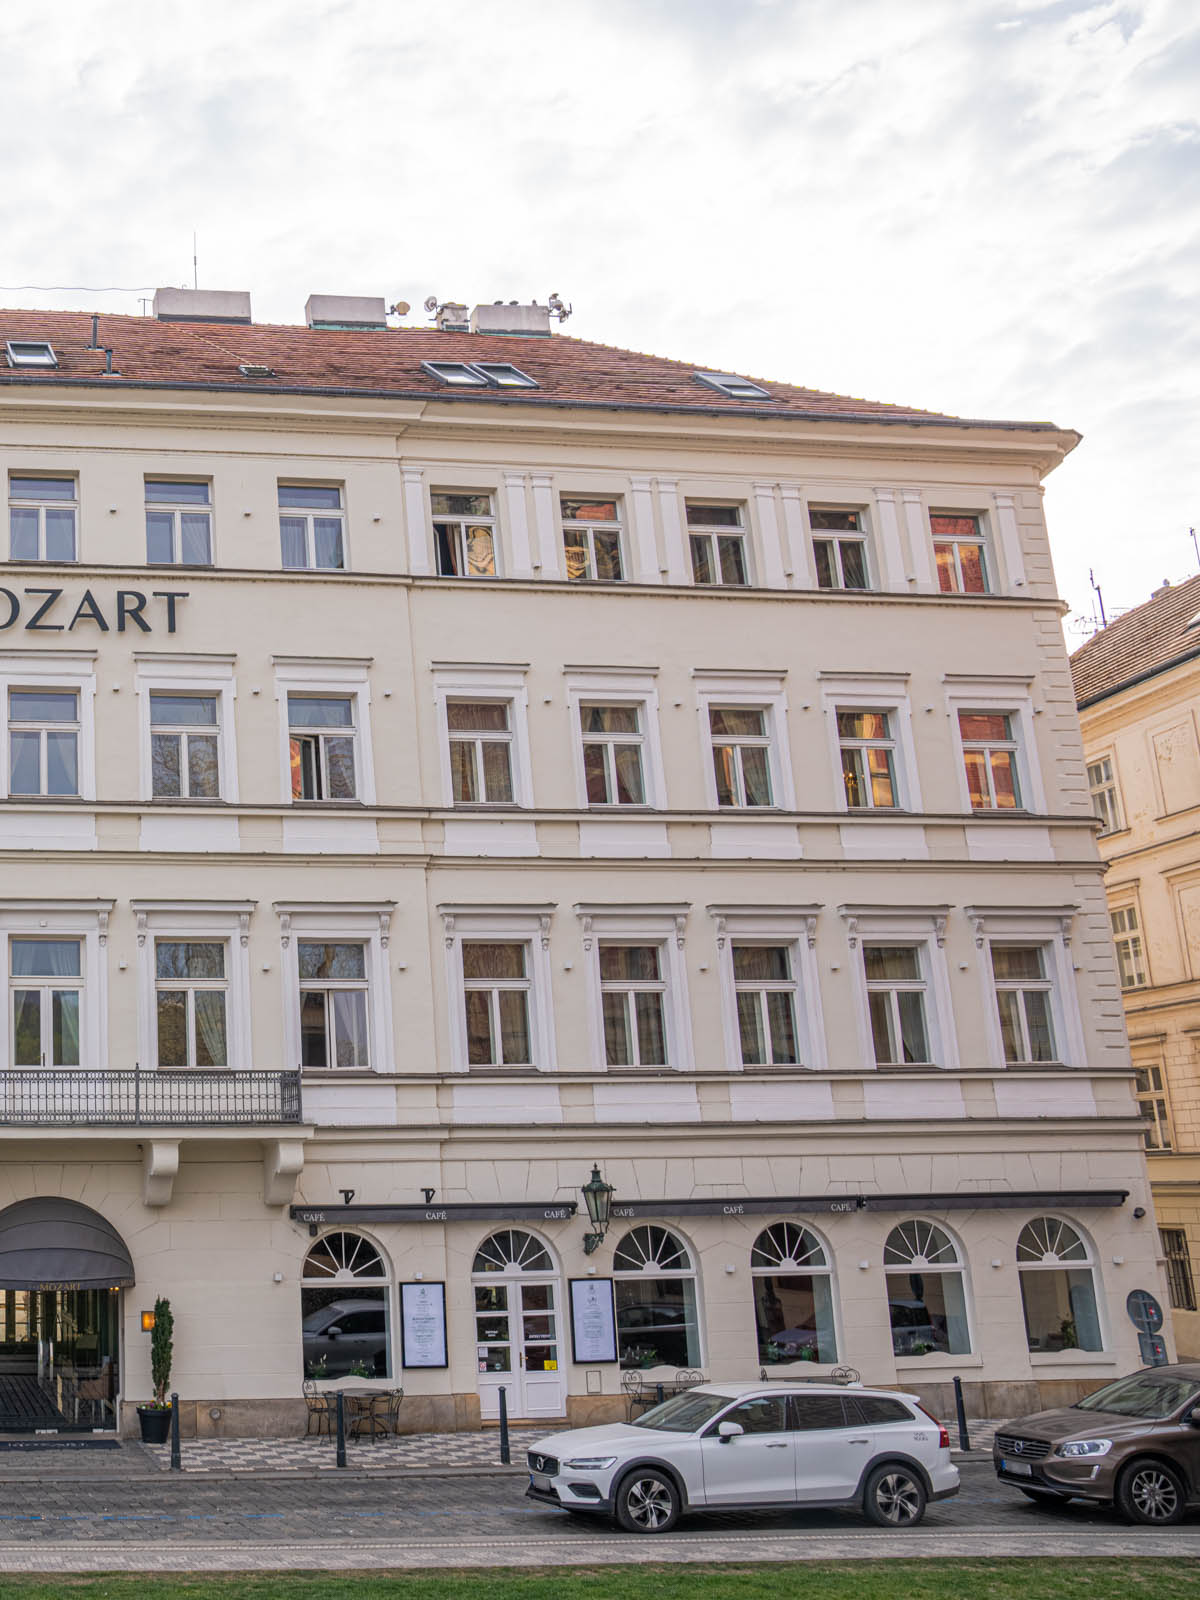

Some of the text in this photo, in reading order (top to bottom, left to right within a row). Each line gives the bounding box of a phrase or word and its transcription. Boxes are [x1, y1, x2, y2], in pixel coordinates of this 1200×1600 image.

[613, 1207, 634, 1217] CAFÉ
[723, 1205, 744, 1214] CAFÉ
[831, 1203, 852, 1212] CAFÉ
[303, 1213, 326, 1222] CAFÉ
[425, 1211, 447, 1220] CAFÉ
[544, 1208, 566, 1218] CAFÉ
